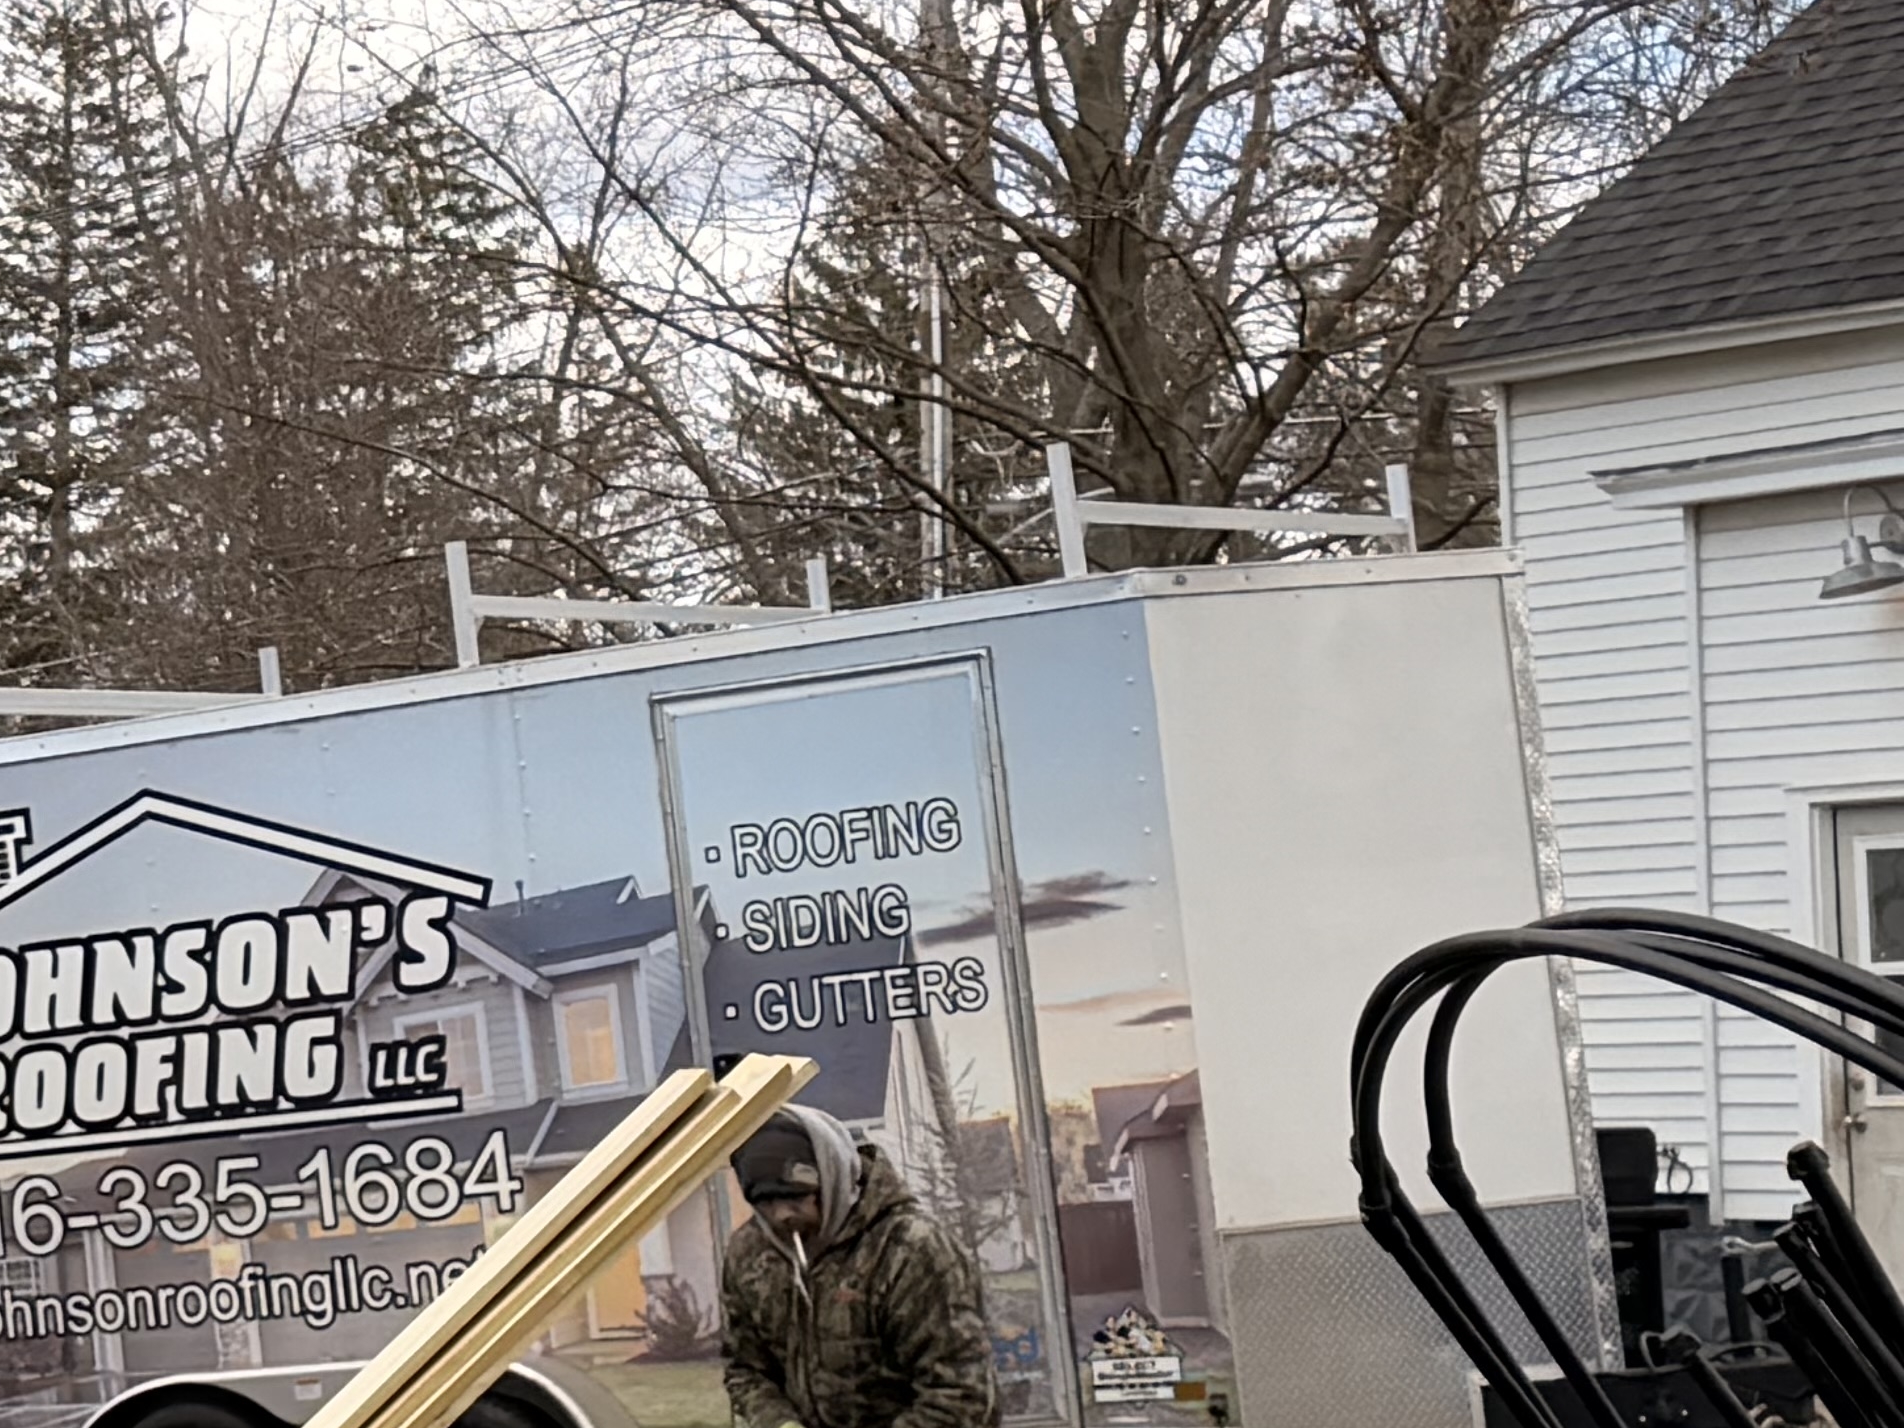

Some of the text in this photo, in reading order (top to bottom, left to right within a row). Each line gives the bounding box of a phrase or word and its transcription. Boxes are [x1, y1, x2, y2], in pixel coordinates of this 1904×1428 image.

[730, 797, 962, 878] ROOFING
[743, 883, 911, 954] SIDING
[753, 957, 989, 1033] GUTTERS
[368, 1035, 448, 1095] LLC
